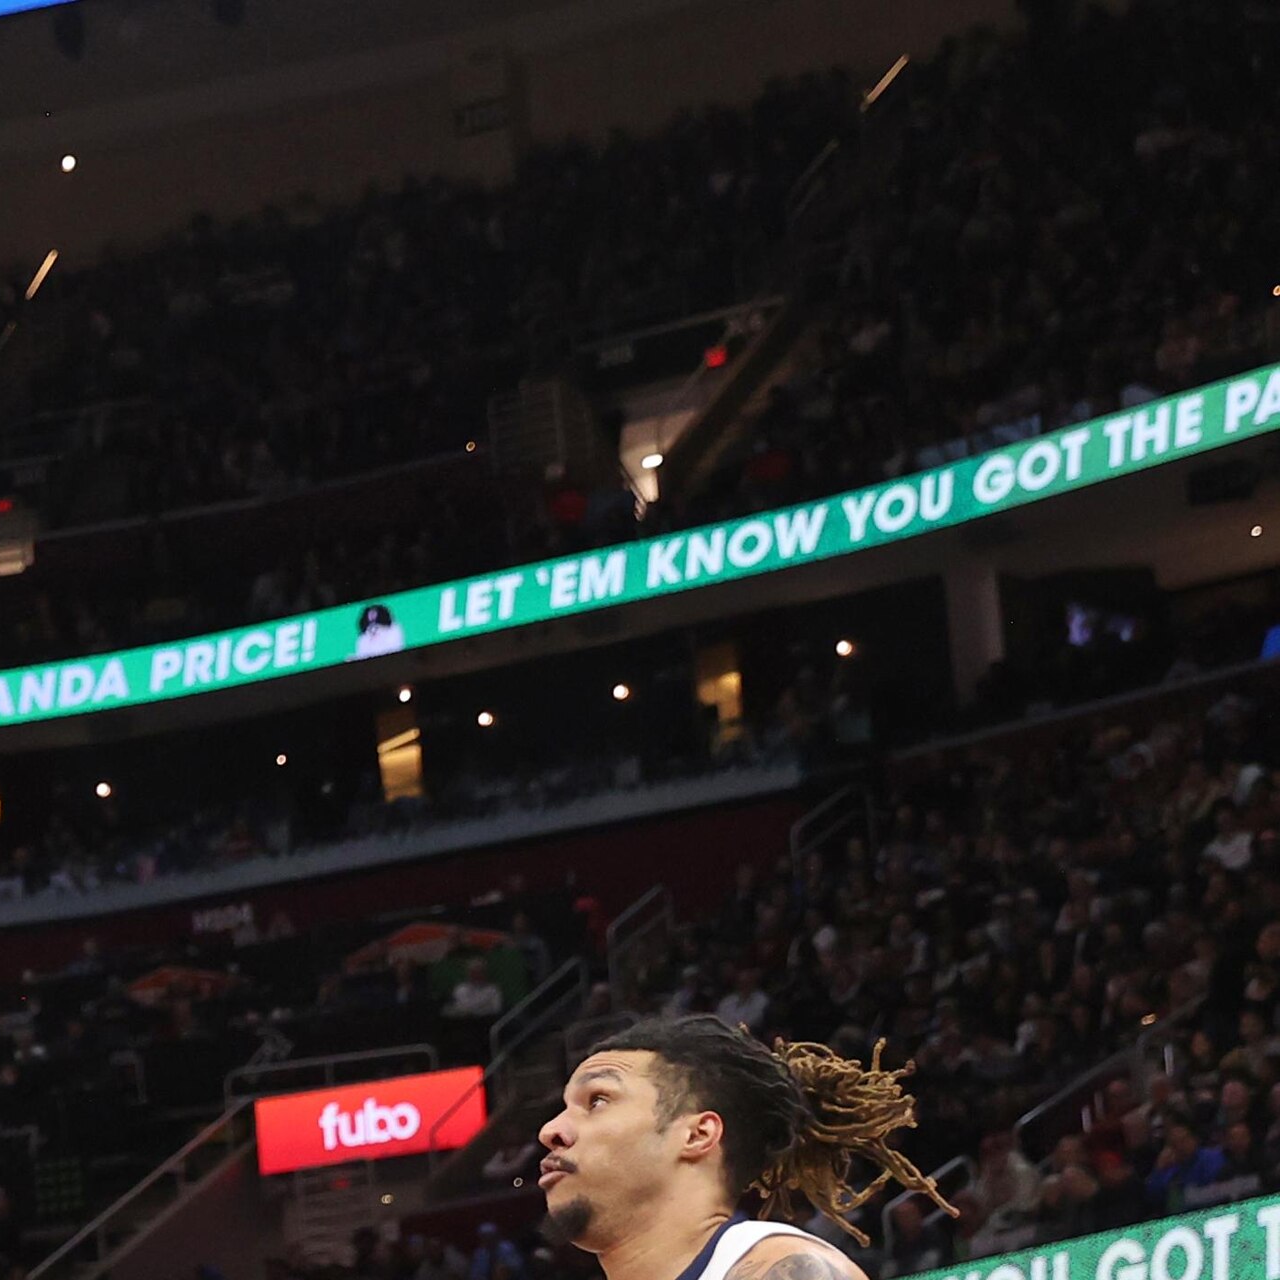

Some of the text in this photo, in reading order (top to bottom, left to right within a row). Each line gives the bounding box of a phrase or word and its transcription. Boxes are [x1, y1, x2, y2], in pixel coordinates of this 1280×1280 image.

[439, 575, 521, 632] LET
[646, 502, 828, 589] KNOW
[843, 468, 955, 544] YOU
[972, 430, 1090, 505] GOT
[1103, 393, 1205, 468] THE
[149, 618, 318, 692] PRICE!
[320, 1096, 421, 1151] fubo
